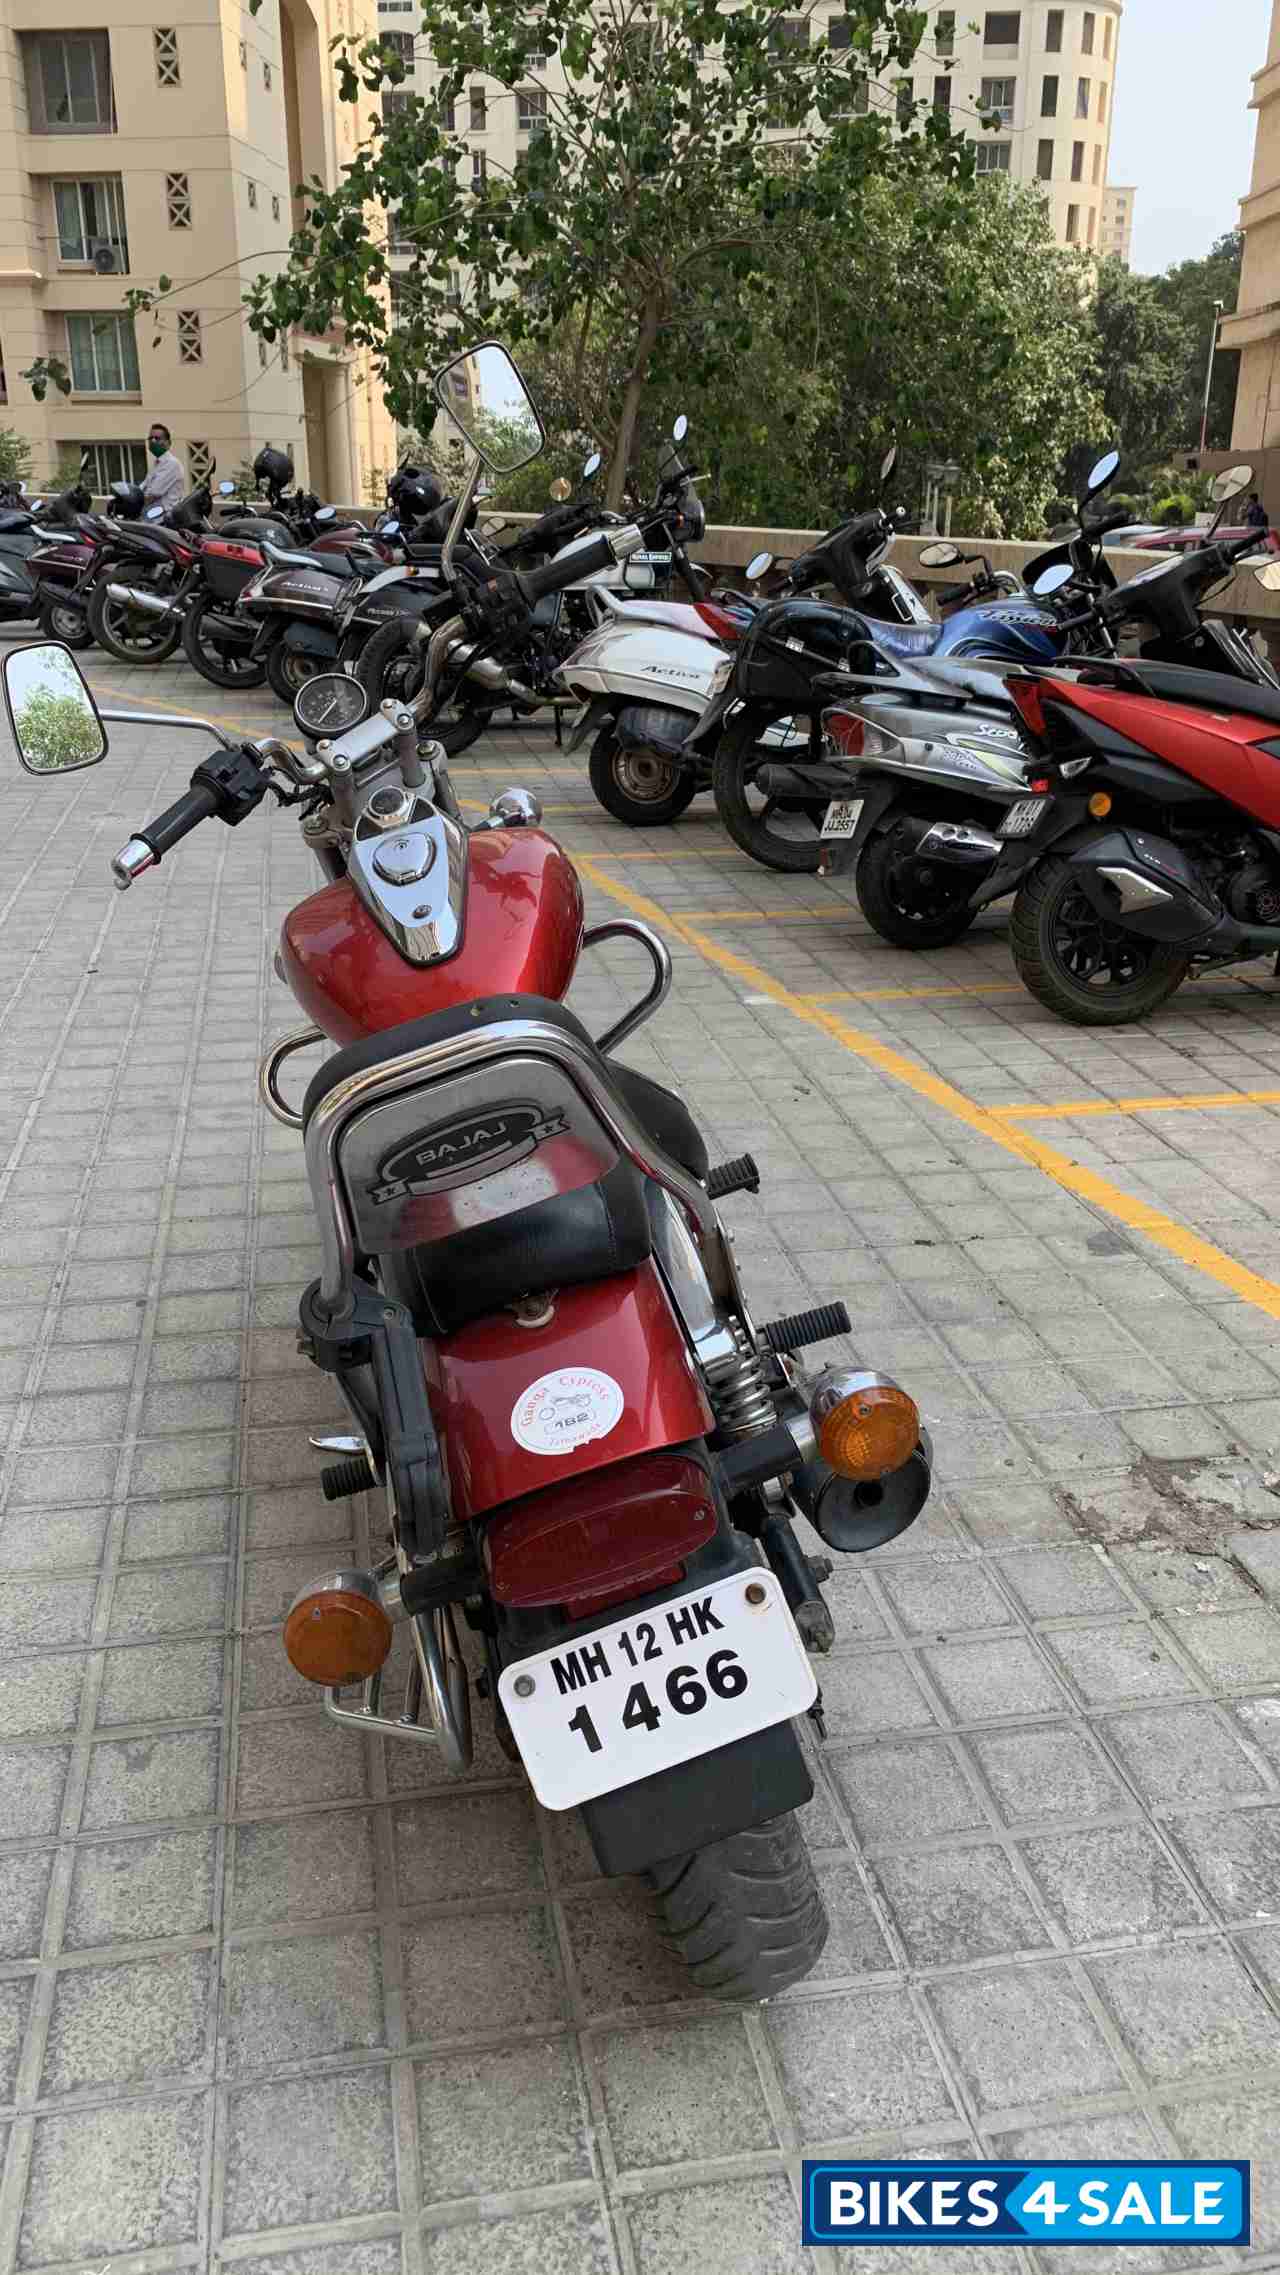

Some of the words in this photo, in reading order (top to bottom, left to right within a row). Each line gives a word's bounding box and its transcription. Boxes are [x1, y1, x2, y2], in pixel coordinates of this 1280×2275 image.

[415, 1121, 508, 1166] BAJAJ
[550, 1641, 612, 1696] MH
[617, 1622, 663, 1667] 12
[665, 1596, 726, 1646] HK
